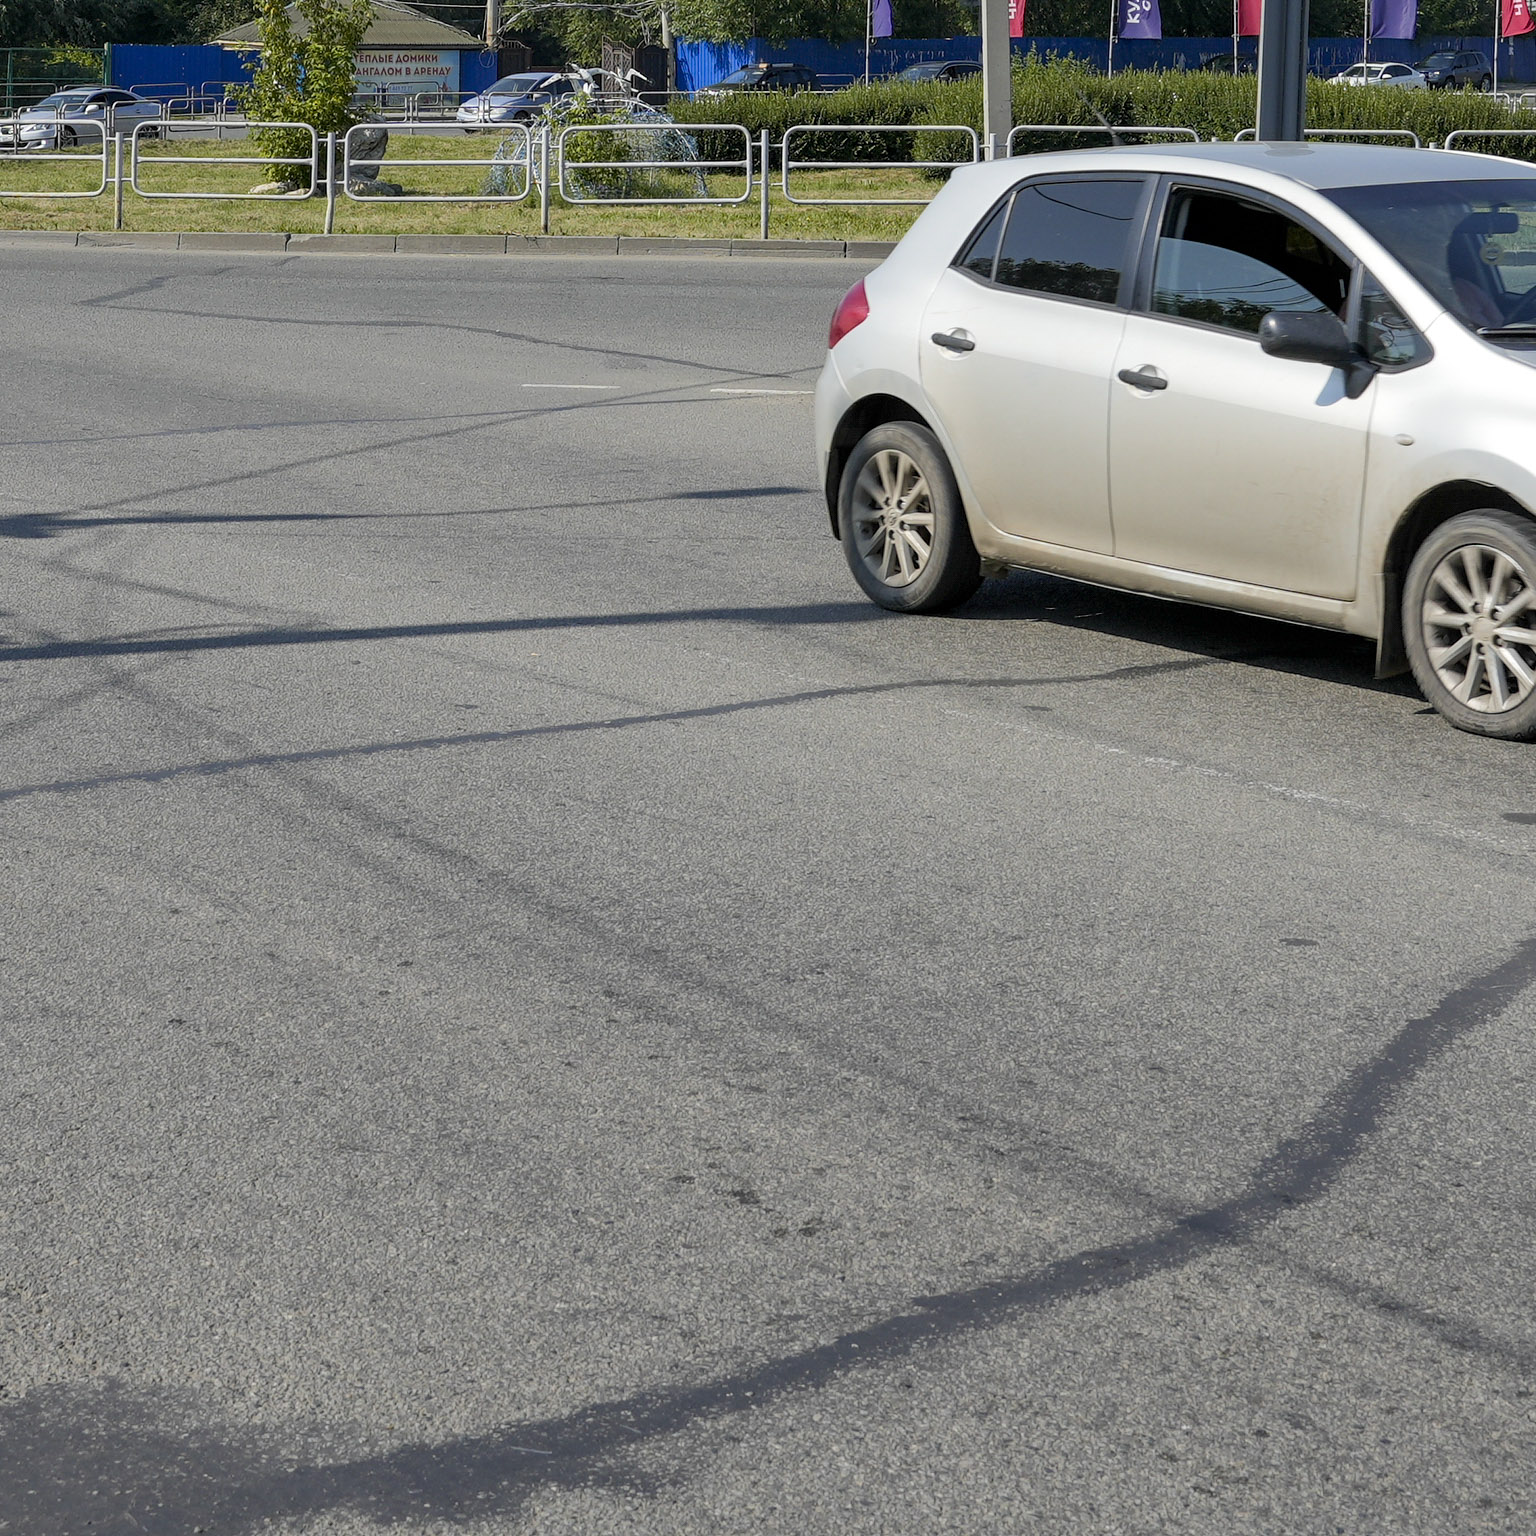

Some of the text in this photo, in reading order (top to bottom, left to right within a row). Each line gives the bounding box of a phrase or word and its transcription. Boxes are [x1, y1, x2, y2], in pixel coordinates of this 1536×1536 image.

[395, 54, 438, 63] ДОМИКИ
[355, 67, 451, 76] АНГАЛОМ В АРЕНДУ
